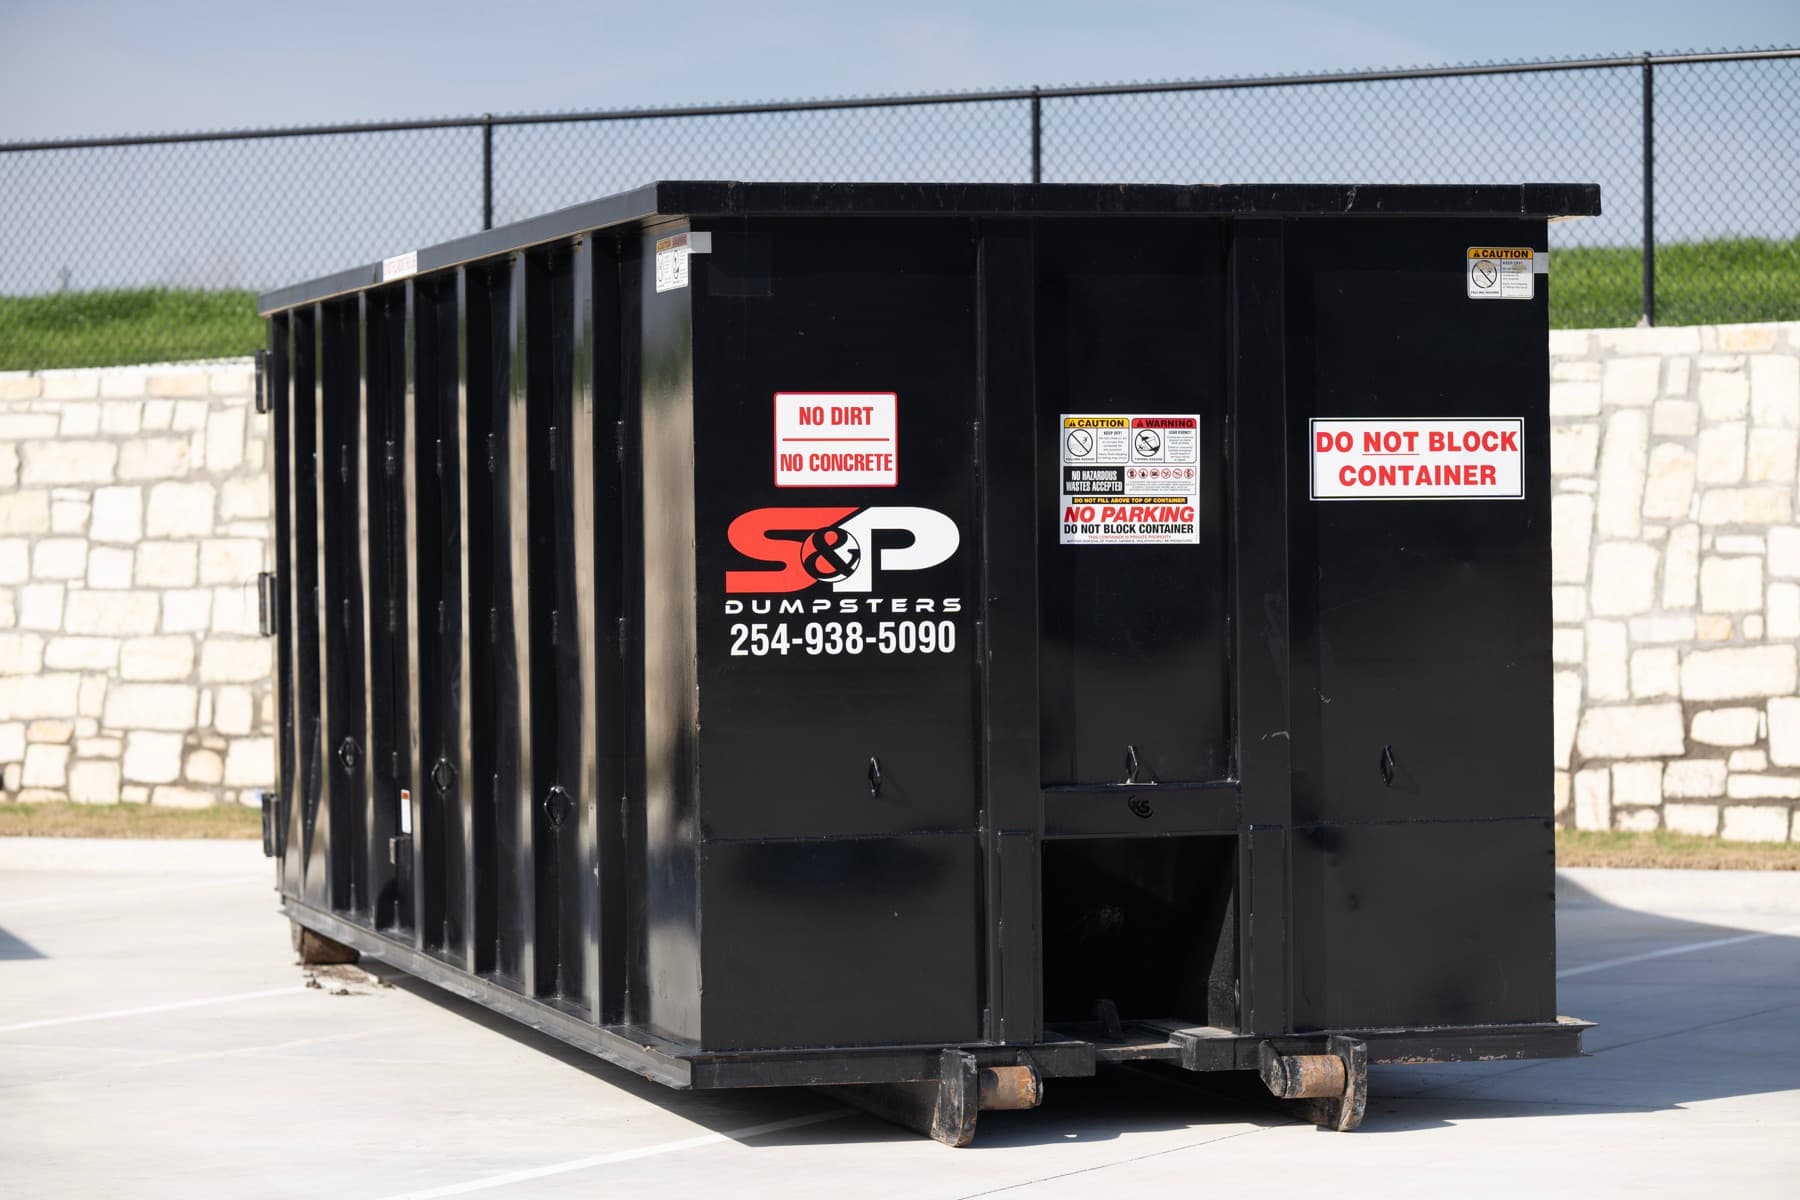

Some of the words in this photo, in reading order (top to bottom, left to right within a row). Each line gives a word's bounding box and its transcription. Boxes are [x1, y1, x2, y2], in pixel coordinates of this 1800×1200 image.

[1482, 250, 1528, 258] CAUTION
[799, 406, 824, 425] NO
[831, 406, 874, 425] DIRT
[1078, 419, 1124, 427] CAUTION
[1146, 419, 1193, 428] WARNING
[1316, 431, 1353, 453] DO
[1363, 431, 1420, 453] NOT
[1429, 431, 1518, 452] BLOCK
[780, 453, 803, 472] NO
[809, 453, 893, 472] CONCRETE
[1072, 470, 1080, 480] NO
[1082, 470, 1117, 480] HAZARDOUS
[1339, 464, 1496, 486] CONTAINER
[1066, 481, 1091, 491] WASTES
[1092, 481, 1122, 491] ACCEPTED
[1064, 506, 1095, 522] NO
[1101, 506, 1194, 522] PARKING
[1064, 524, 1077, 534] DO
[1081, 524, 1100, 534] NOT
[1104, 524, 1136, 534] BLOCK
[1139, 524, 1193, 534] CONTAINER
[726, 507, 960, 593] S&P
[725, 598, 961, 614] DUMPSTERS
[730, 621, 956, 656] 254-938-5090
